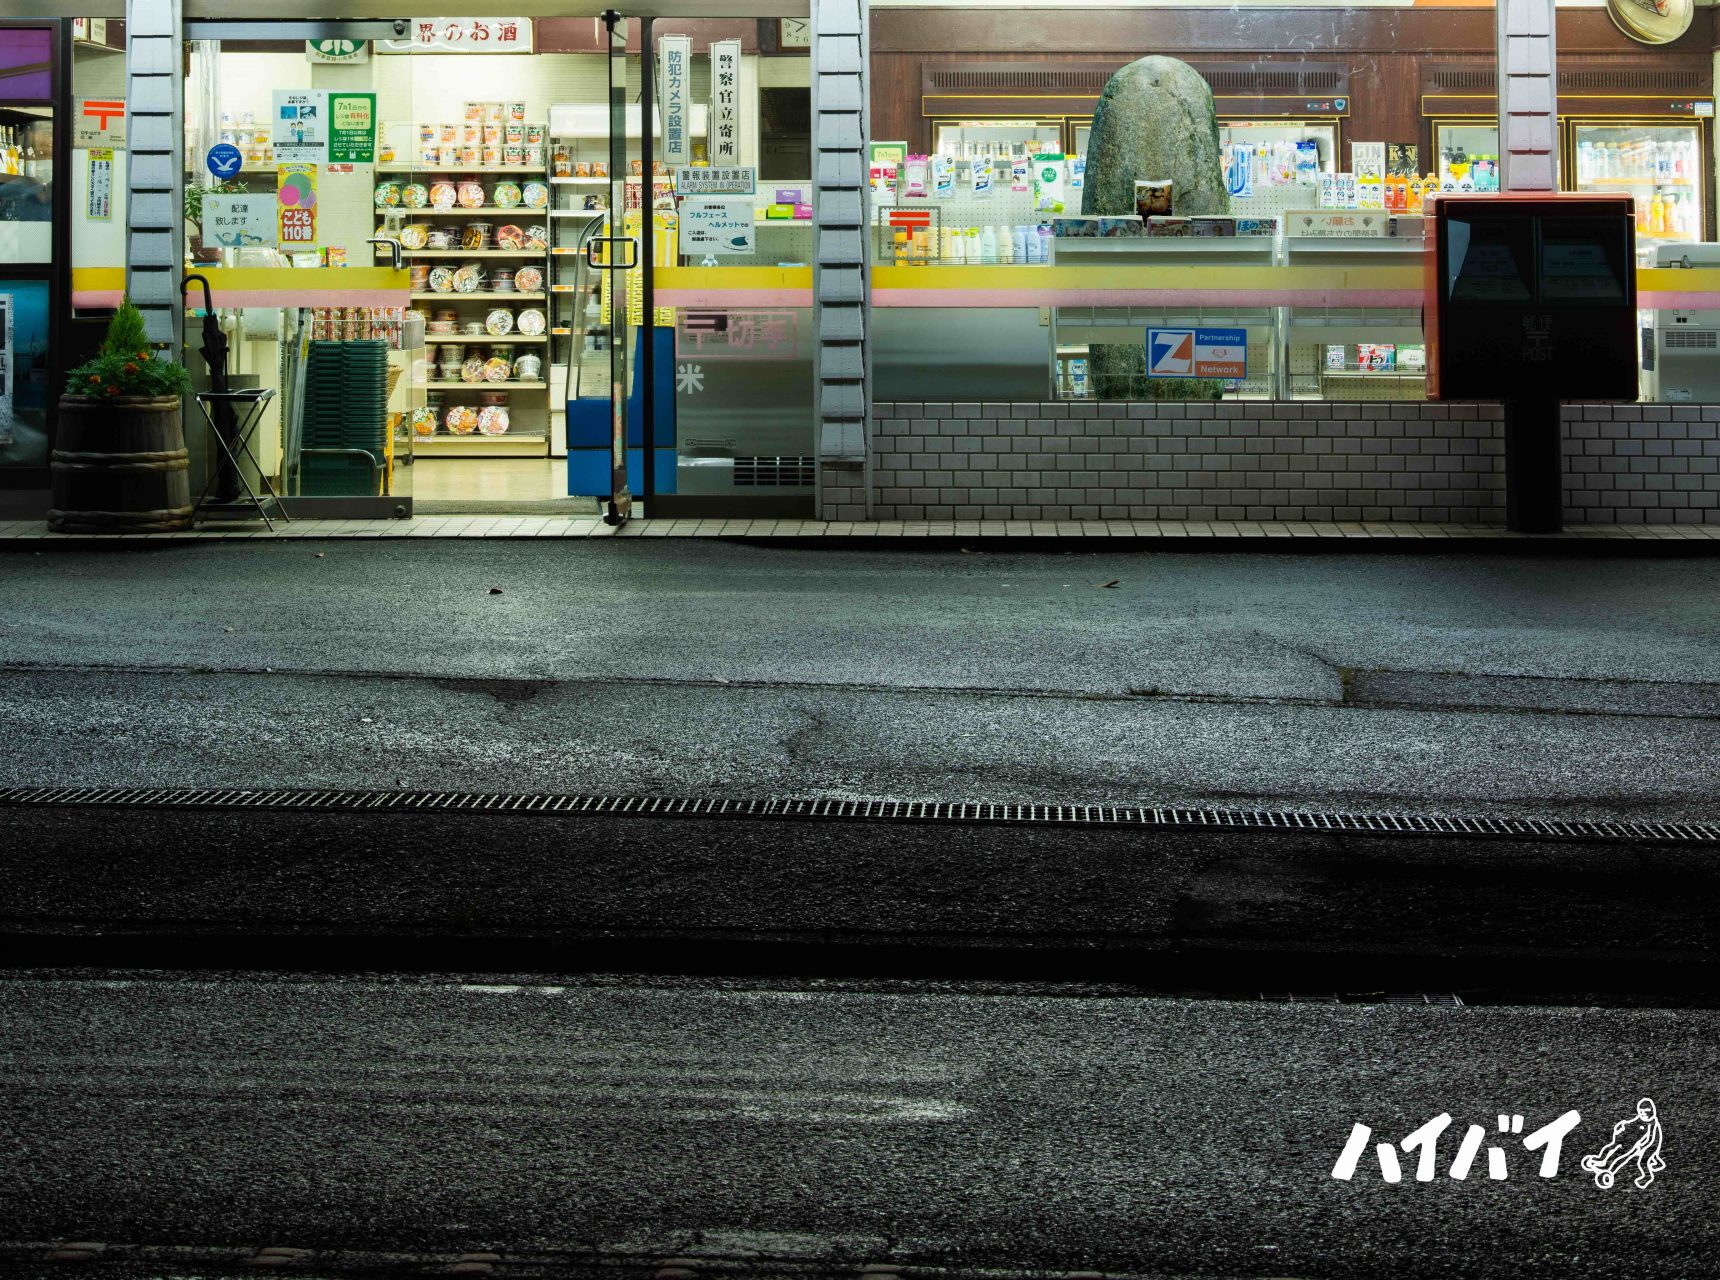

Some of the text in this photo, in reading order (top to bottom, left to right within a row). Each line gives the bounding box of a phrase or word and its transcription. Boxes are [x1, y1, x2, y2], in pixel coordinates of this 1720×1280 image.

[416, 21, 518, 42] 界のお酒
[668, 50, 682, 154] 防犯カメラ設置店
[719, 54, 733, 156] 警察官立寄所
[682, 170, 750, 181] 警報装置設置店
[698, 181, 718, 189] SYSTEM
[231, 204, 249, 213] 配達
[215, 217, 247, 226] 致します
[283, 211, 313, 226] こども
[283, 226, 313, 241] 110番
[1199, 334, 1241, 342] Partnership
[1522, 346, 1553, 361] POST
[1200, 365, 1238, 373] Network
[676, 363, 704, 394] 米
